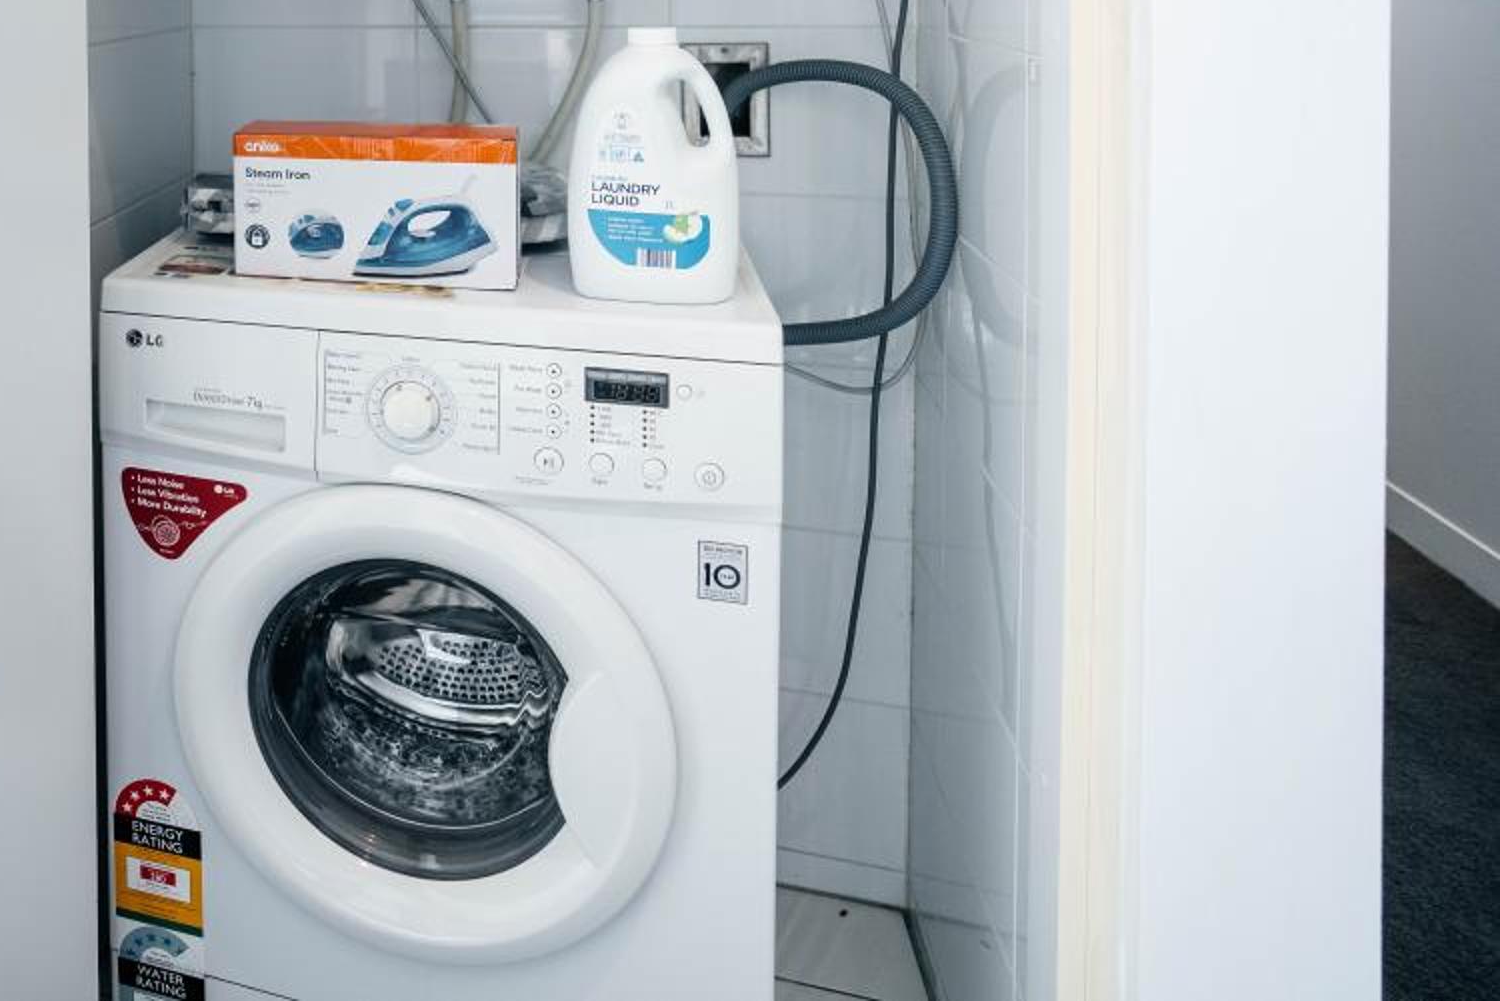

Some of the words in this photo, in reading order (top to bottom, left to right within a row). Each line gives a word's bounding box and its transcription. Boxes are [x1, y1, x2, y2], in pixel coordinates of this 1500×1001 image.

[245, 167, 283, 180] Steam
[286, 168, 311, 180] Iron
[591, 181, 660, 197] LAUNDRY
[591, 193, 640, 207] LIQUID
[138, 474, 157, 485] Less
[158, 477, 185, 490] Noise
[138, 485, 157, 496] Less
[158, 488, 200, 503] Vibration
[138, 497, 161, 509] More
[163, 500, 207, 518] Durability
[705, 563, 740, 589] 10
[132, 820, 183, 842] ENERGY
[131, 832, 183, 854] RATING
[137, 964, 184, 985] WATER
[135, 975, 187, 999] RATING
